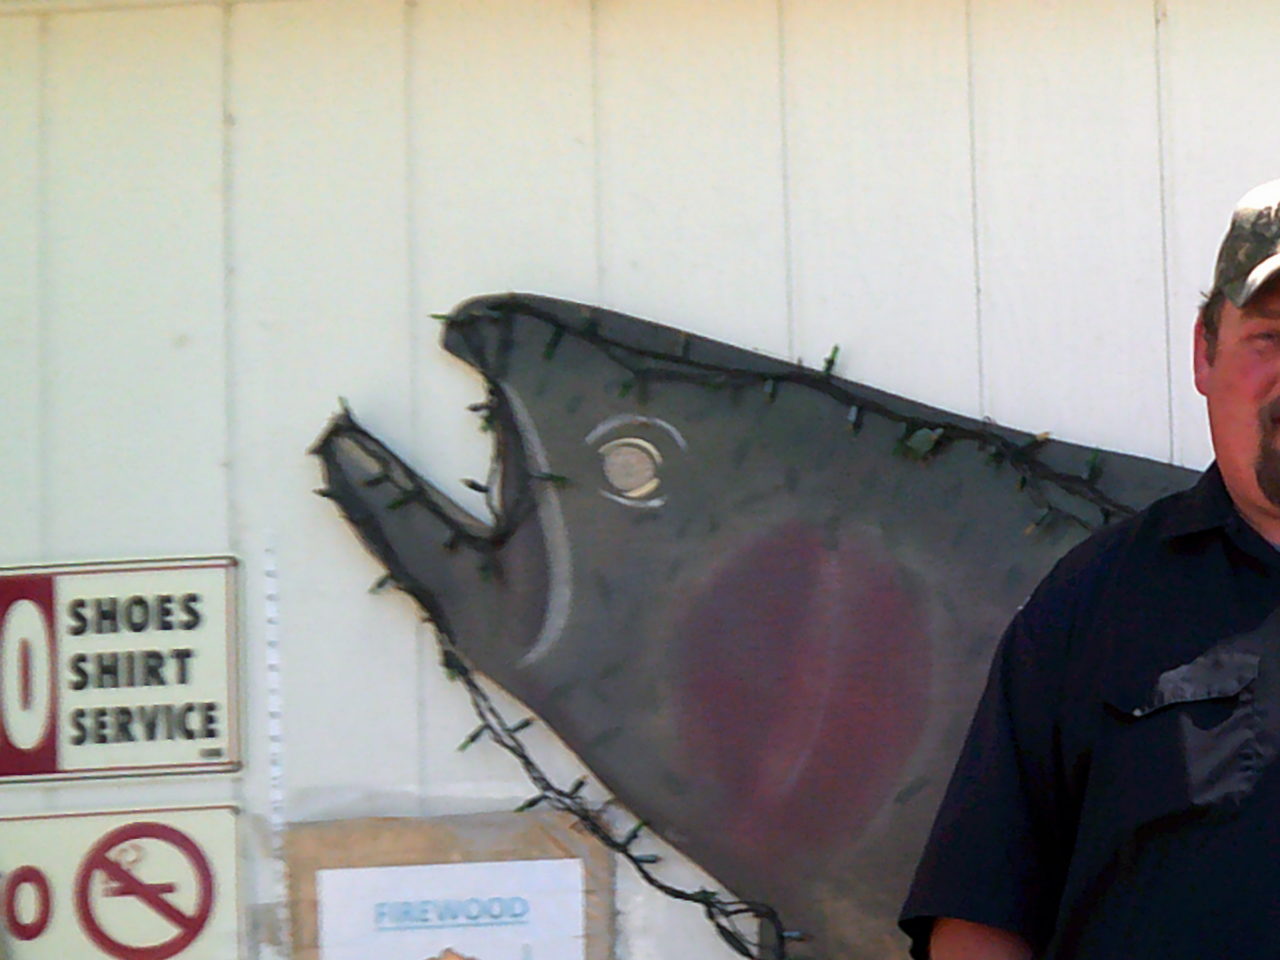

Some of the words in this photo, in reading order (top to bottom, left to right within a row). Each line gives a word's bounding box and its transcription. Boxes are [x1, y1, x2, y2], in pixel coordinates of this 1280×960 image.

[67, 593, 202, 635] SHOES
[68, 649, 193, 690] SHIRT
[69, 703, 218, 745] SERVICE
[374, 896, 530, 924] FIREWOOD
